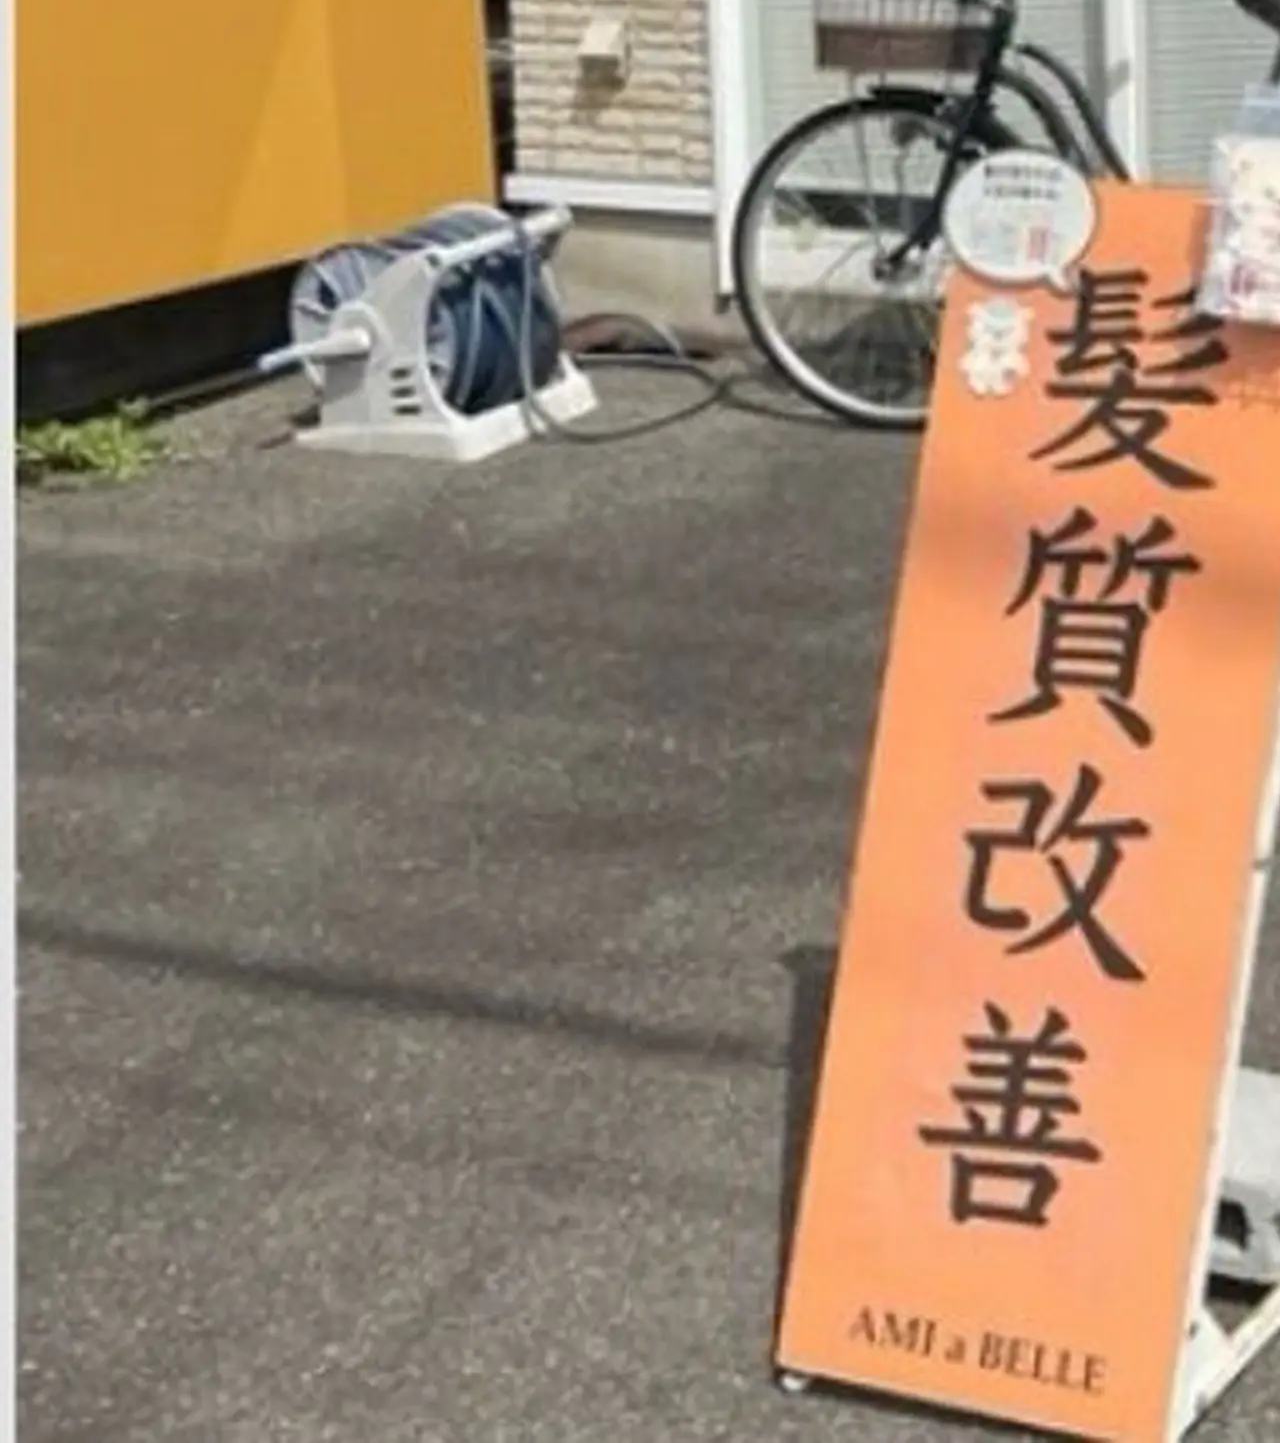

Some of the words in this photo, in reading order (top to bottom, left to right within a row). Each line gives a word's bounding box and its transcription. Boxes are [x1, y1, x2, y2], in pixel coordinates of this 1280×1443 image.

[917, 267, 1230, 1228] 髪質改善
[849, 1306, 936, 1356] AMI
[944, 1335, 966, 1363] a
[978, 1330, 1107, 1393] BELLE
